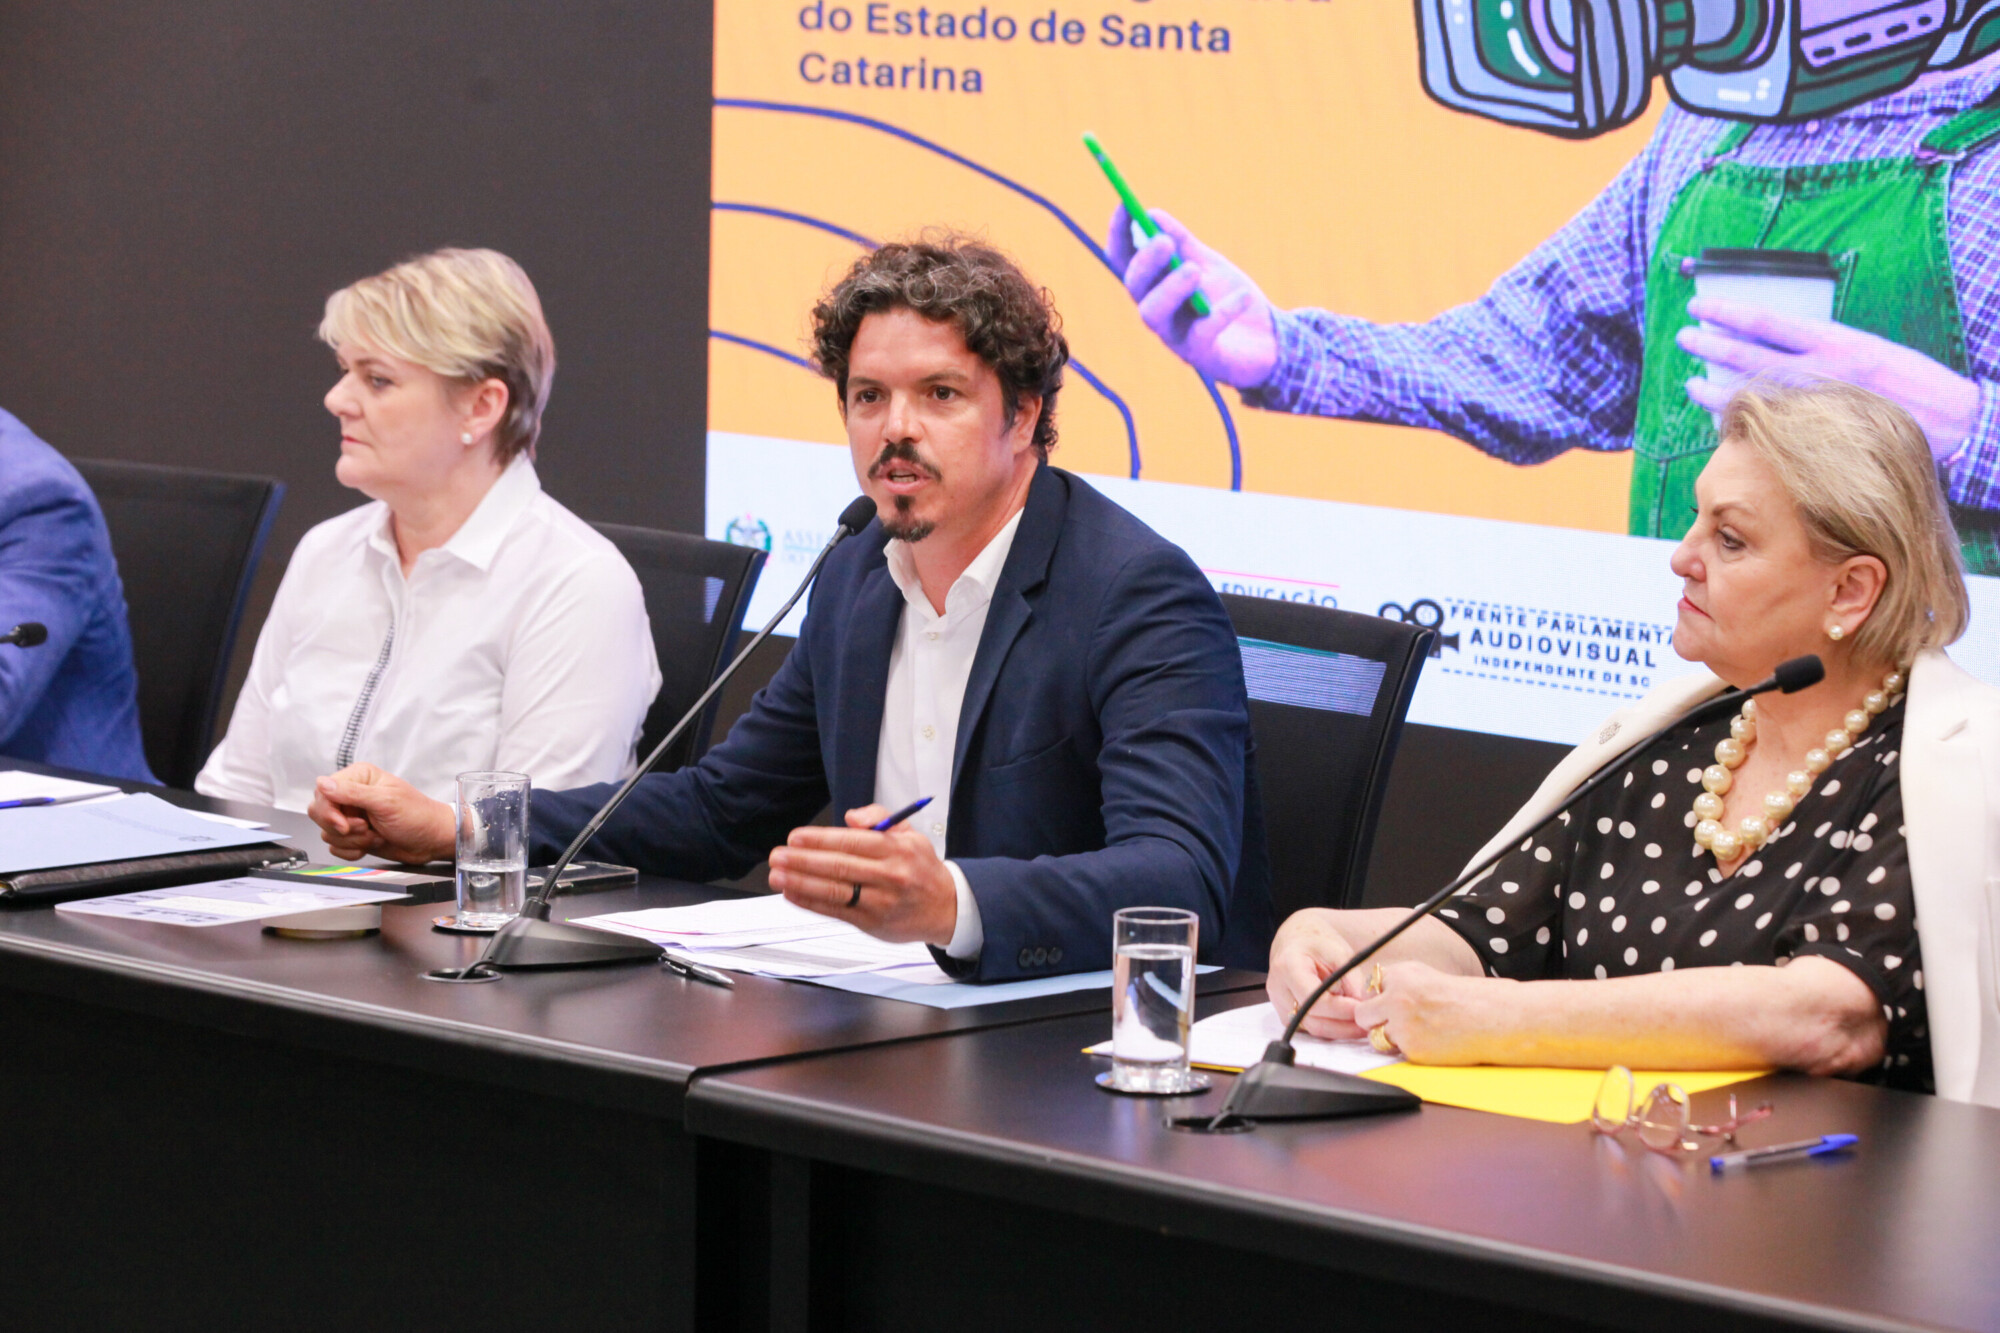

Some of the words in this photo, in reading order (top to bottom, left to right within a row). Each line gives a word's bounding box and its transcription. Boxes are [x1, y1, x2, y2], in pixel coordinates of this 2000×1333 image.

[799, 0, 852, 31] do
[867, 3, 1017, 40] Estado
[1030, 10, 1085, 44] de
[1100, 14, 1231, 52] Santa
[799, 52, 983, 93] Catarina
[1451, 605, 1526, 628] FRENTE
[1470, 628, 1656, 668] AUDIOVISUAL
[1474, 655, 1596, 681] INDEPENDENTE
[1603, 672, 1622, 684] DE
